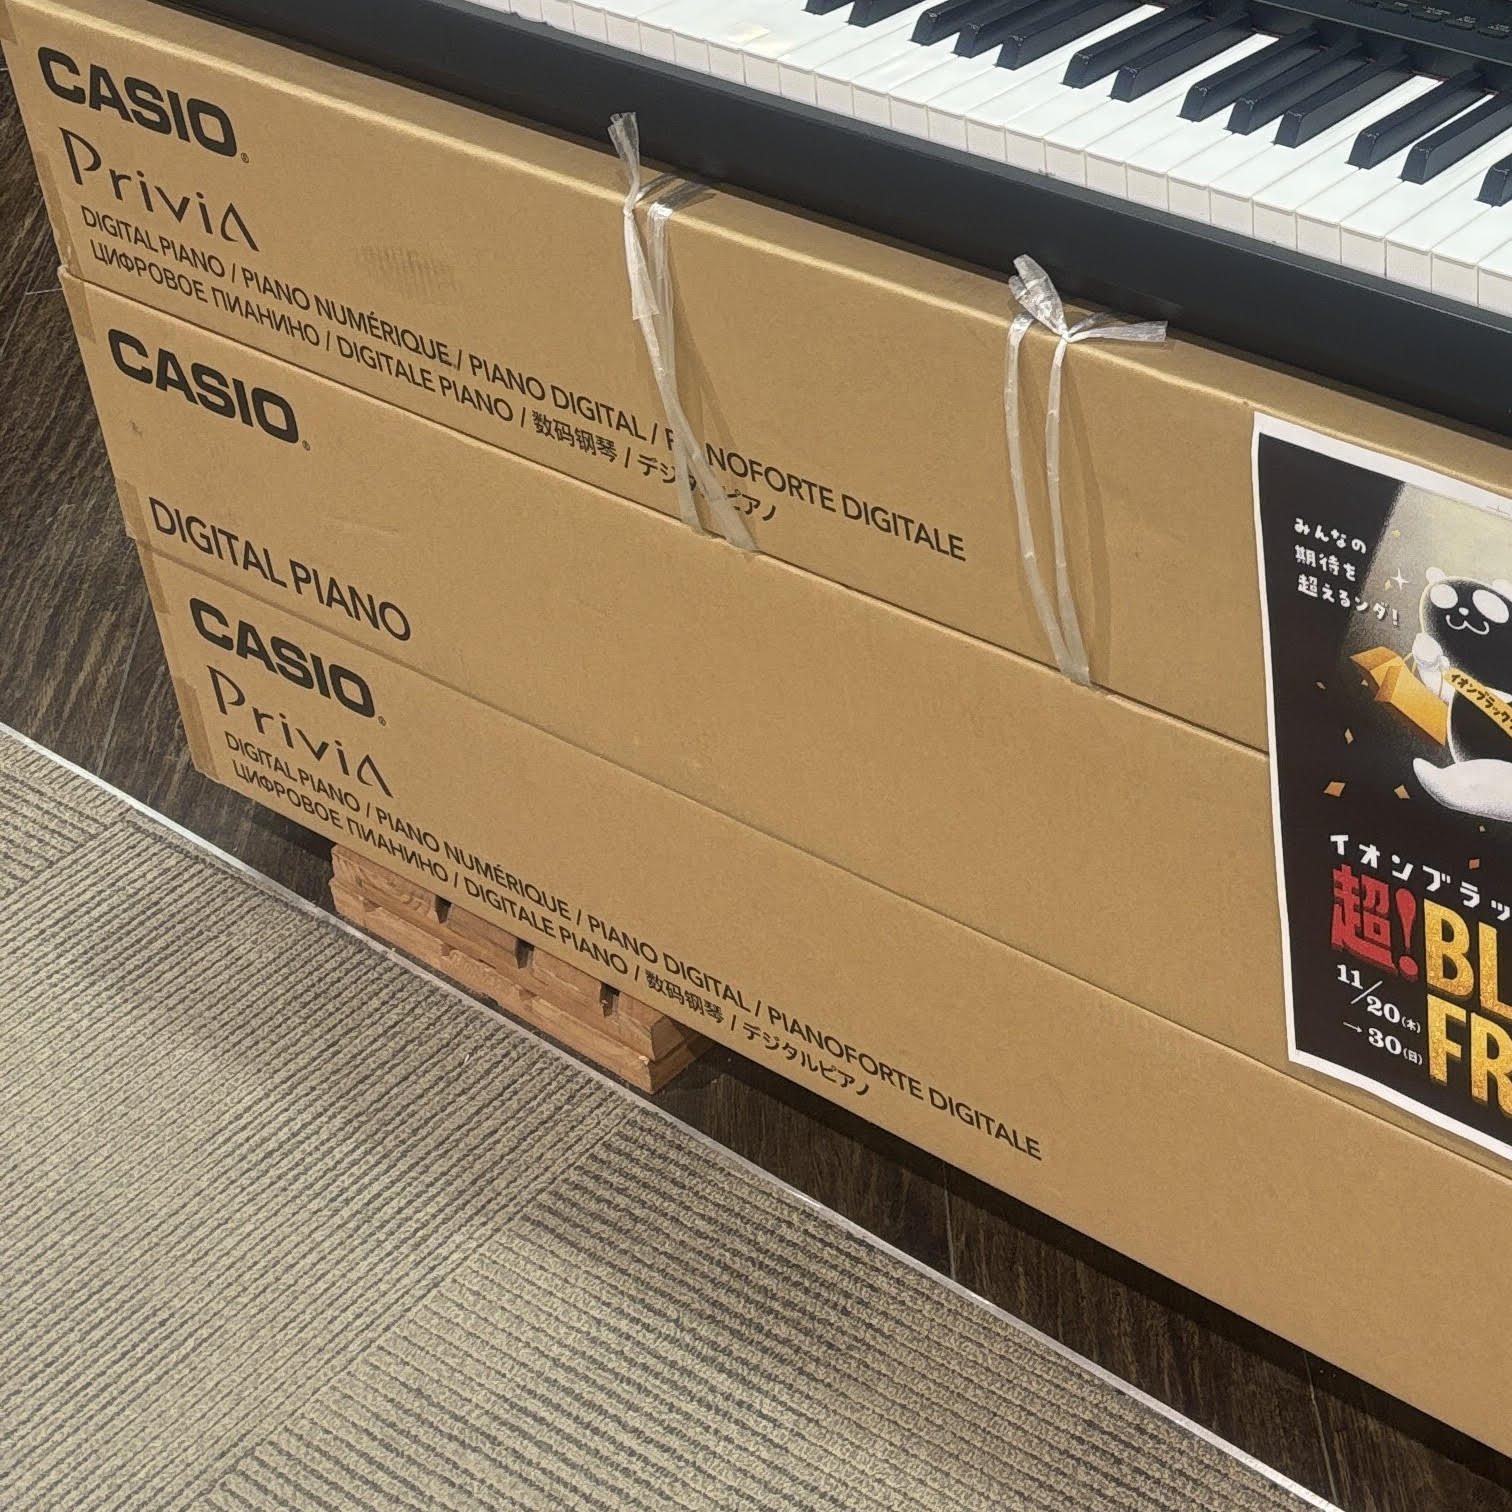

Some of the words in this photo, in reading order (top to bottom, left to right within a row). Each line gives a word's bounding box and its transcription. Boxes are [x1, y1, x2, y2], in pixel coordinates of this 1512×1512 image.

[37, 46, 238, 158] CASIO
[80, 204, 158, 254] DIGITAL
[159, 236, 226, 279] PIANO
[241, 266, 310, 312] PIANO
[314, 292, 450, 366] NUMÉRIQUE
[468, 352, 546, 401] PIANO
[550, 385, 647, 442] DIGITAL
[664, 426, 837, 513] PNOFORTE
[841, 491, 967, 562] DIGITALE
[90, 238, 206, 302] ЦИФРОВОЕ
[211, 286, 321, 348] ПИАНИНО
[336, 335, 436, 393] DIGITALE
[440, 374, 514, 423] PIANO
[531, 409, 619, 464] 数码钢琴
[637, 453, 778, 523] デジピアノ
[107, 328, 299, 445] CASIO
[148, 496, 288, 589] DIGITAL
[288, 558, 412, 642] PIANO
[1294, 517, 1367, 555] みんなの
[1294, 544, 1357, 583] 期待を
[189, 597, 376, 720] CASIO
[224, 730, 300, 786] DIGITAL
[297, 767, 361, 814] PIANO
[375, 805, 441, 855] PIANO
[443, 840, 572, 922] NUMÉRIQUE
[587, 913, 659, 965] PIANO
[662, 950, 752, 1017] DIGITAL
[767, 1003, 925, 1101] PIANOFORTE
[927, 1086, 1043, 1162] DIGITALE
[231, 758, 343, 829] ЦИФРОВОЕ
[346, 814, 449, 885] ПИАНИНО
[463, 877, 557, 939] DIGITALE
[560, 923, 629, 977] PIANO
[644, 968, 725, 1025] 数码钢琴
[741, 1021, 871, 1098] デジタルピアノ
